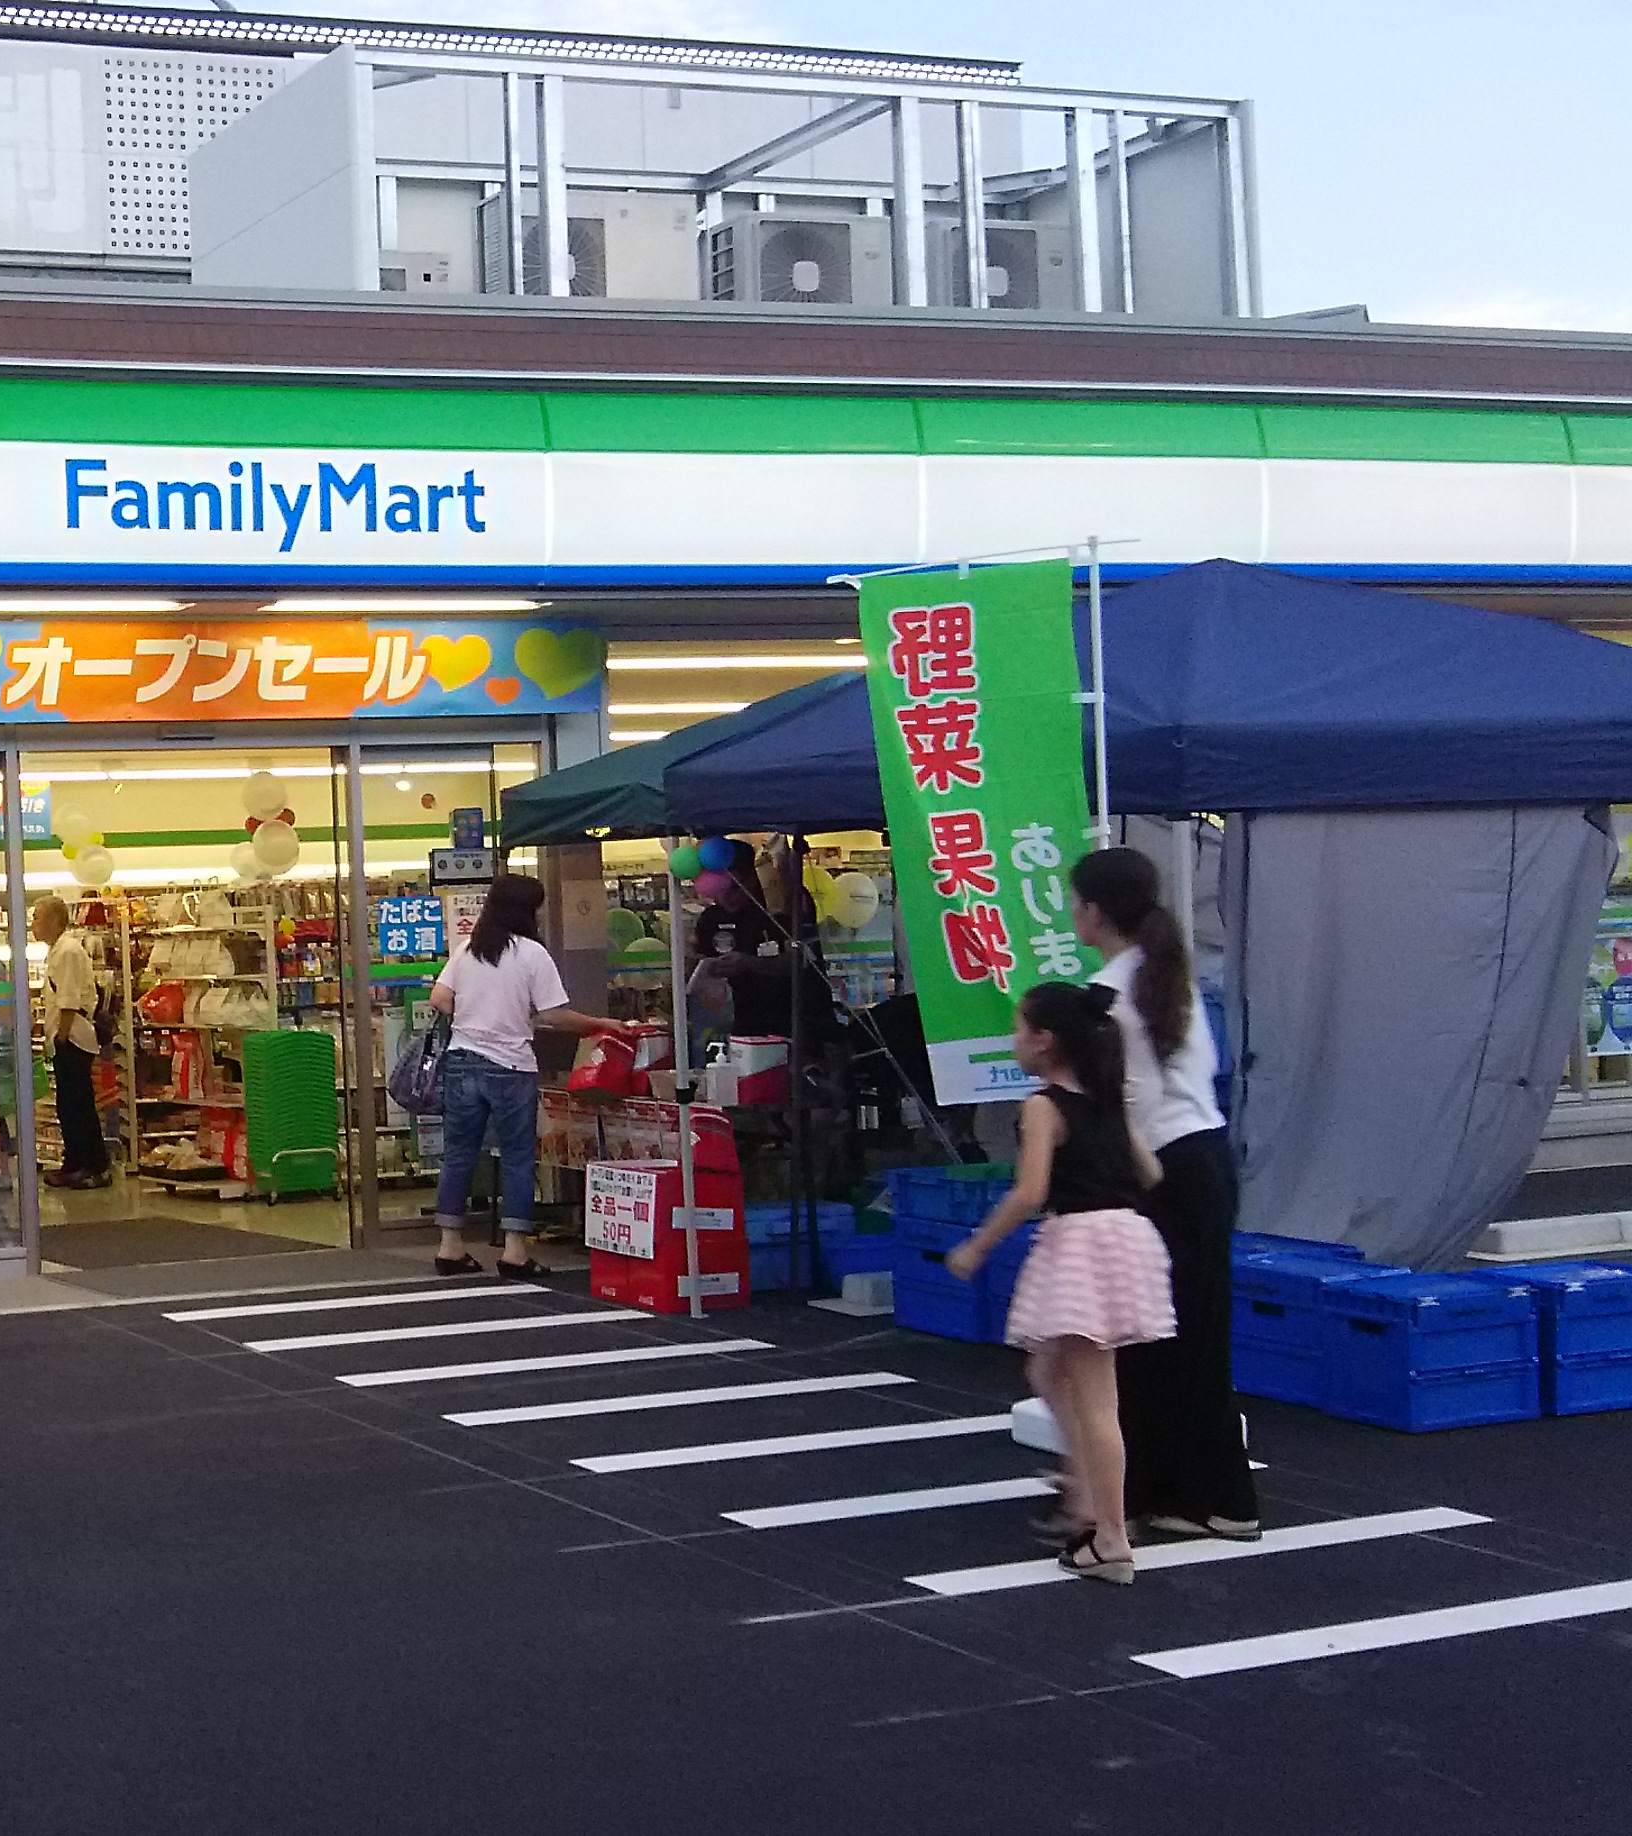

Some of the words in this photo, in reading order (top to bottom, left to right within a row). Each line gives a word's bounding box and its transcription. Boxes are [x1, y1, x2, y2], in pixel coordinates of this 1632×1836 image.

[64, 458, 486, 553] FamilyMart
[5, 634, 427, 705] オープンセール
[379, 899, 442, 924] たばこ
[386, 927, 437, 951] お酒
[602, 1220, 632, 1245] 50円
